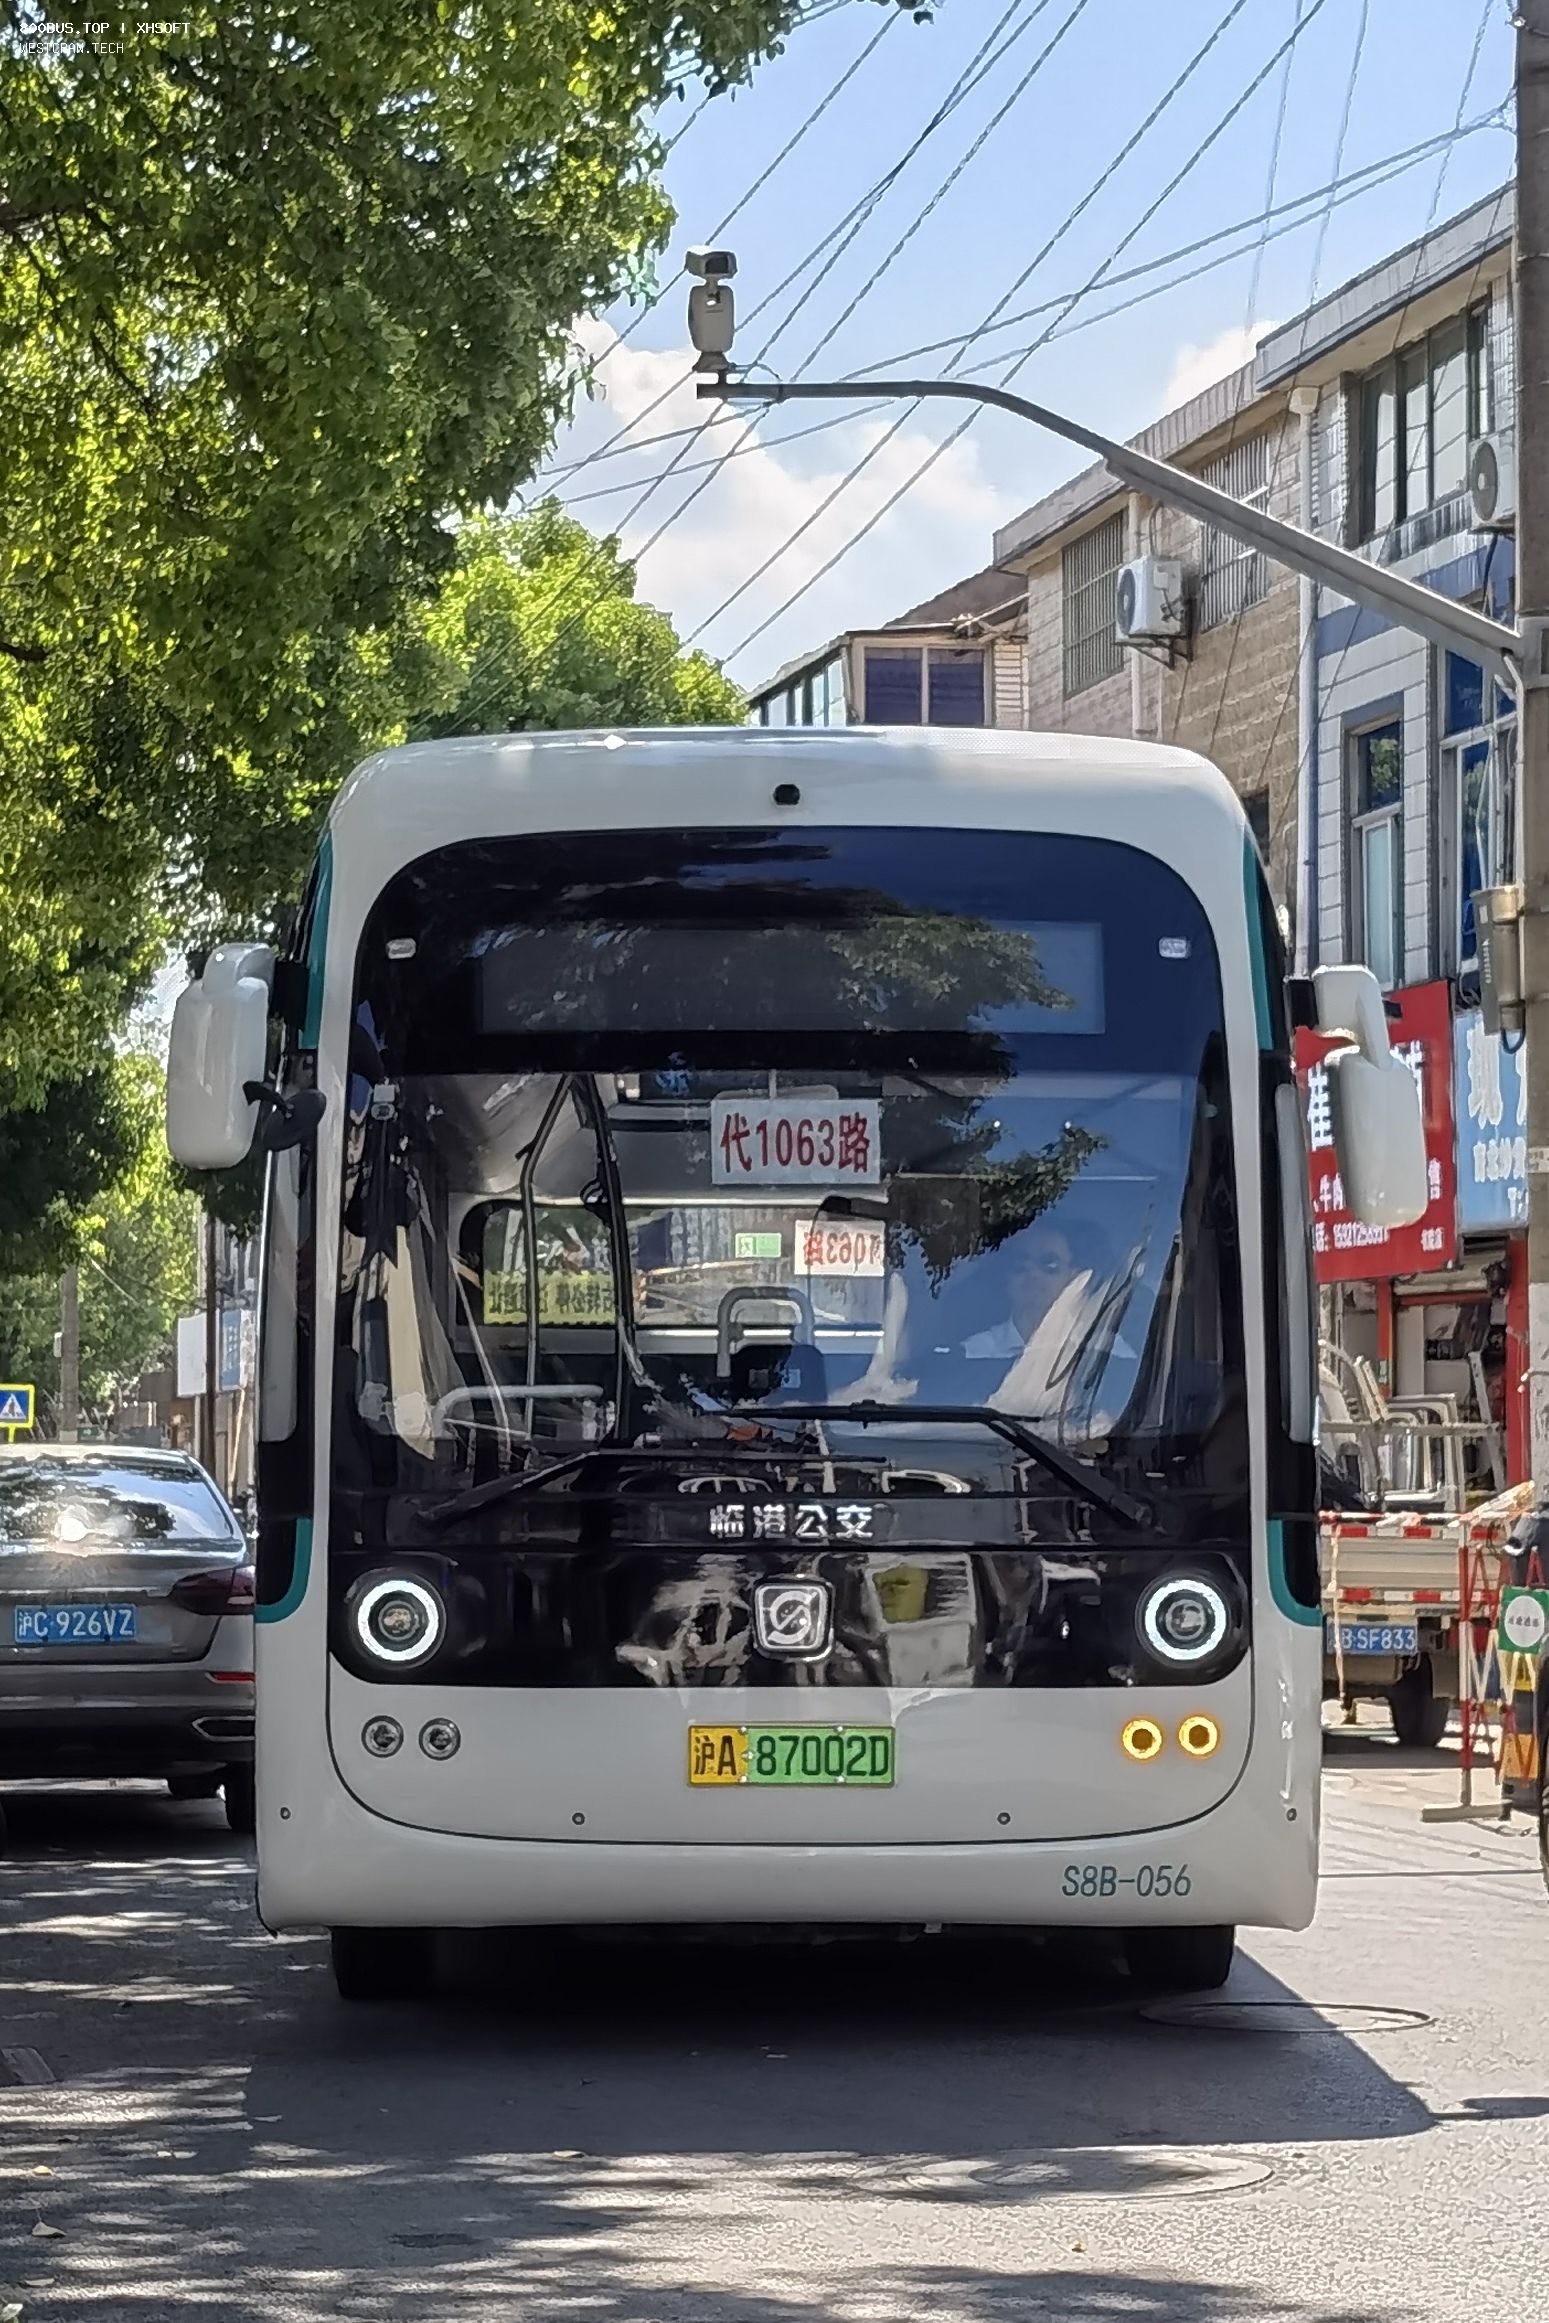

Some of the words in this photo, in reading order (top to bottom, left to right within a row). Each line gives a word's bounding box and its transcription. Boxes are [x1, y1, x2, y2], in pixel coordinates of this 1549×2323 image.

[720, 1112, 870, 1173] 代1063路
[709, 1504, 873, 1539] 临港公交
[1062, 1864, 1191, 1897] S8B-056
